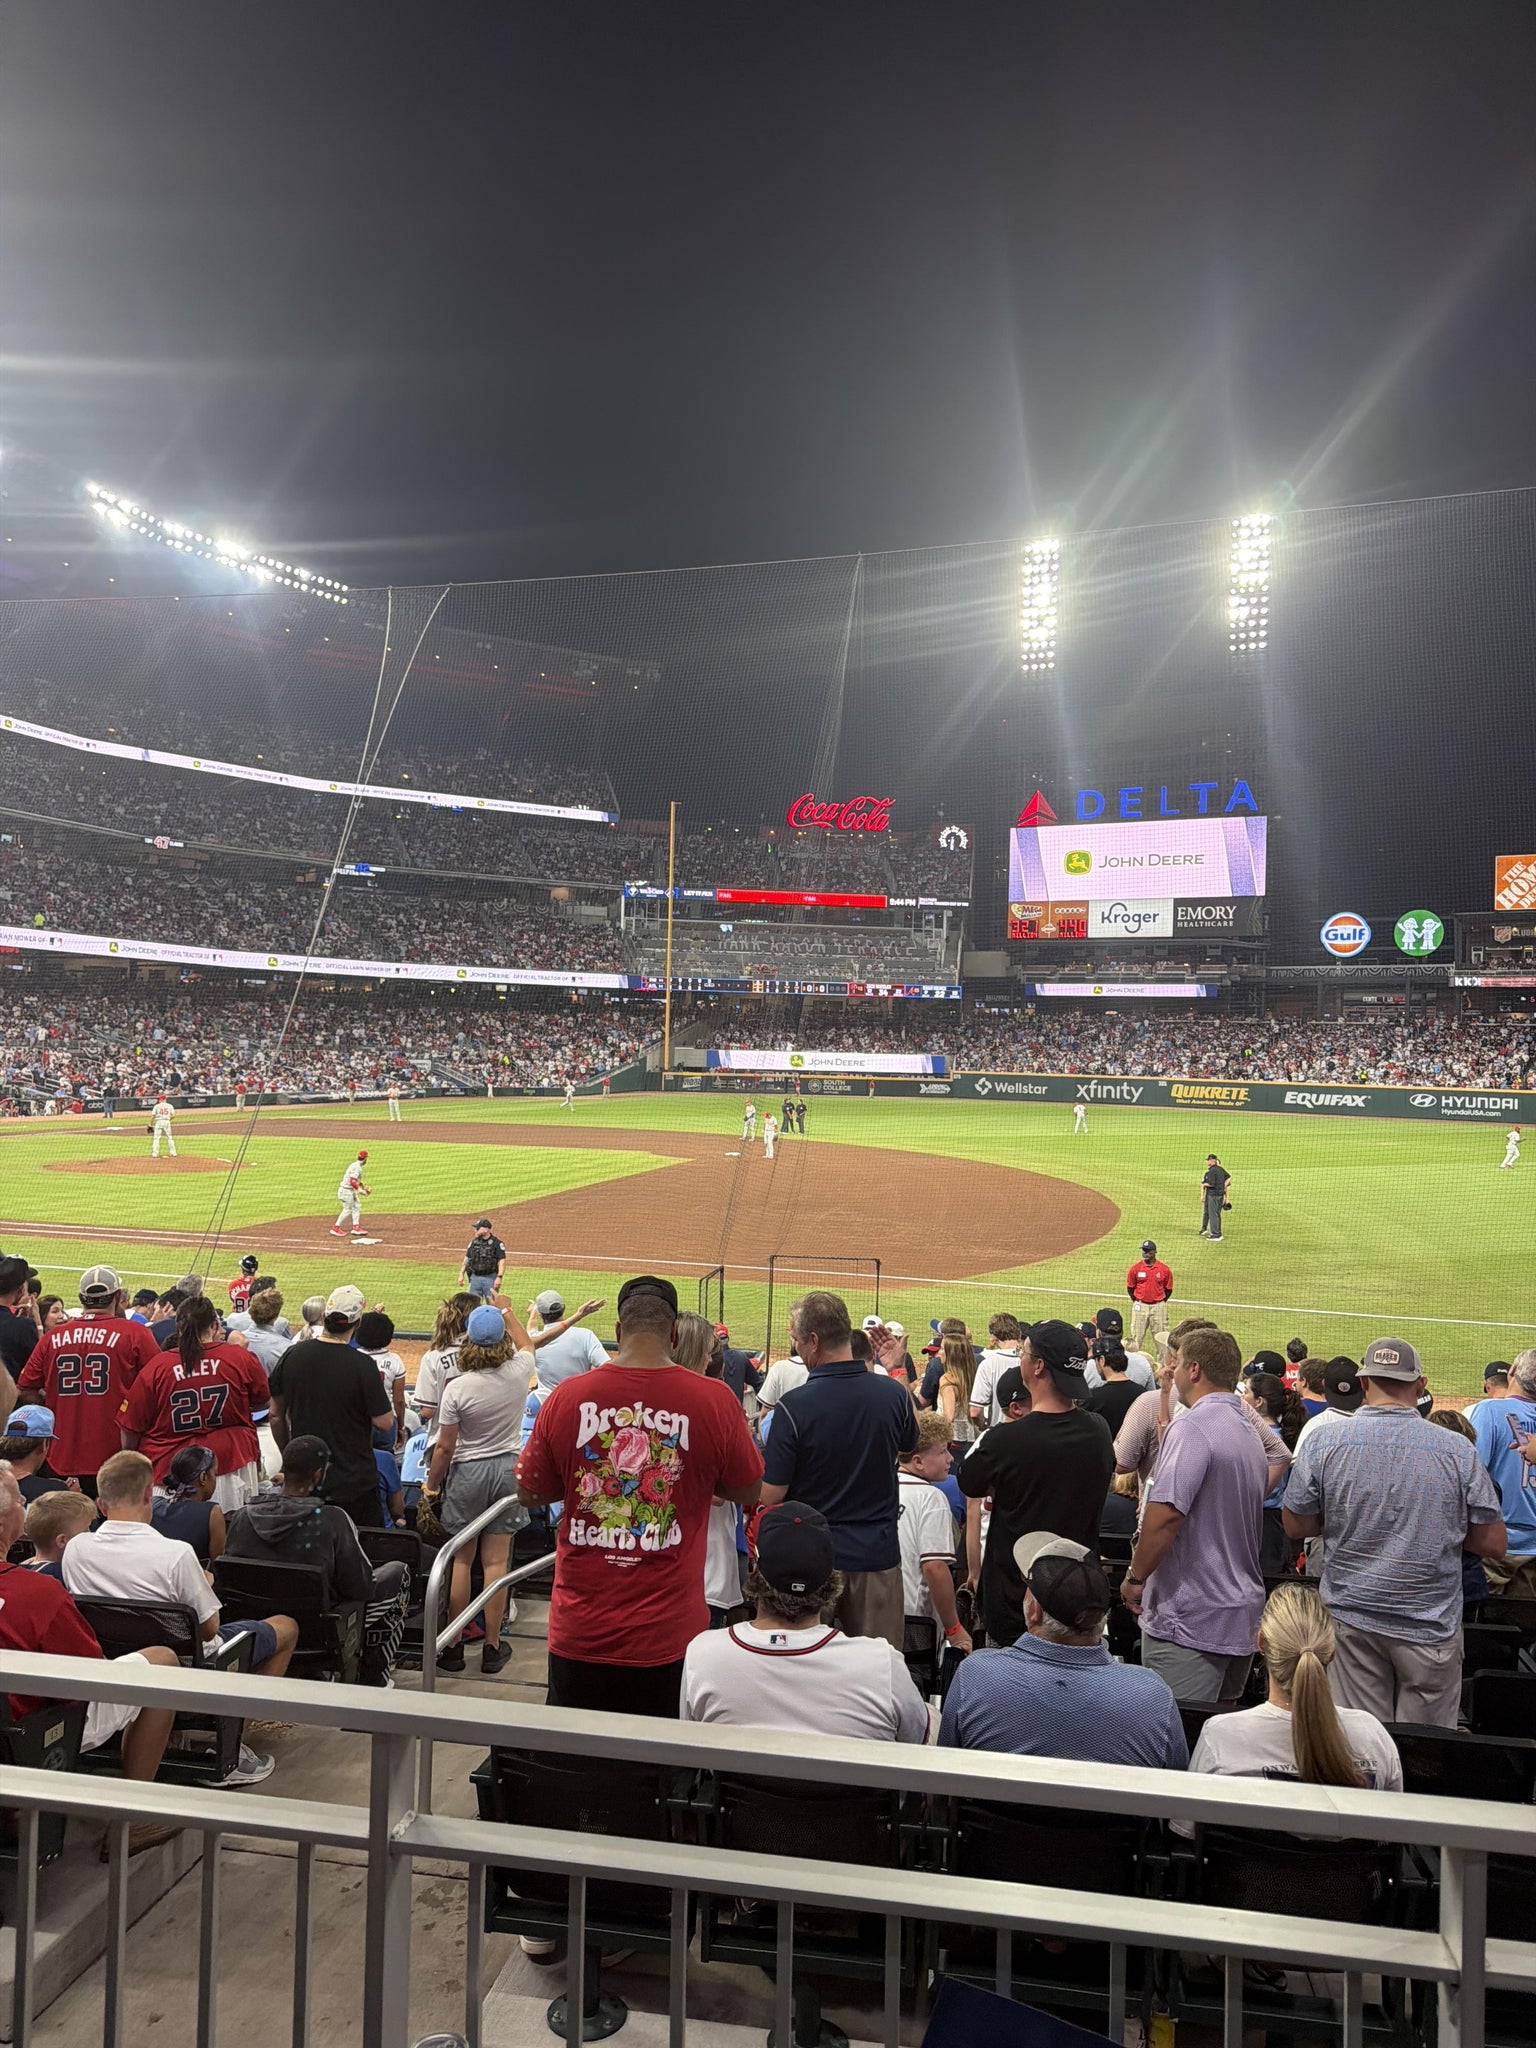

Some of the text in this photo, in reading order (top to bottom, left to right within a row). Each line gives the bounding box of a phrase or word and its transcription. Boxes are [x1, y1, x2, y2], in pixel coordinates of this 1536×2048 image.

[1076, 780, 1258, 821] DELTA
[787, 792, 896, 832] Coca-Cola
[154, 835, 170, 849] 47
[356, 863, 370, 872] 42
[1098, 853, 1205, 869] JOHN DEERE
[1502, 861, 1527, 883] THE
[1101, 903, 1160, 933] Kroger
[1177, 905, 1237, 920] EMORY
[1011, 920, 1039, 932] 321
[1059, 919, 1087, 932] 440
[1177, 920, 1235, 928] HEALTHCARE
[1325, 928, 1367, 942] Gulf
[121, 945, 138, 953] JOHN
[139, 946, 158, 956] DEERE
[470, 971, 488, 979] JOHN
[488, 972, 510, 980] DEERE
[808, 1058, 866, 1067] JOHN DEERE
[994, 1081, 1048, 1095] Wellstar
[1076, 1080, 1143, 1103] xfinity
[1171, 1084, 1249, 1101] QUIKRETE
[1284, 1091, 1366, 1108] EQUIFAX
[1441, 1096, 1518, 1110] HYUNDAI
[1441, 1109, 1501, 1117] HyundaiUSA.com
[51, 1327, 120, 1349] HARRIS II
[57, 1352, 110, 1396] 23
[173, 1359, 220, 1382] RLEY
[170, 1383, 229, 1433] 27
[576, 1401, 690, 1451] Broken
[568, 1517, 682, 1552] Hearts Club
